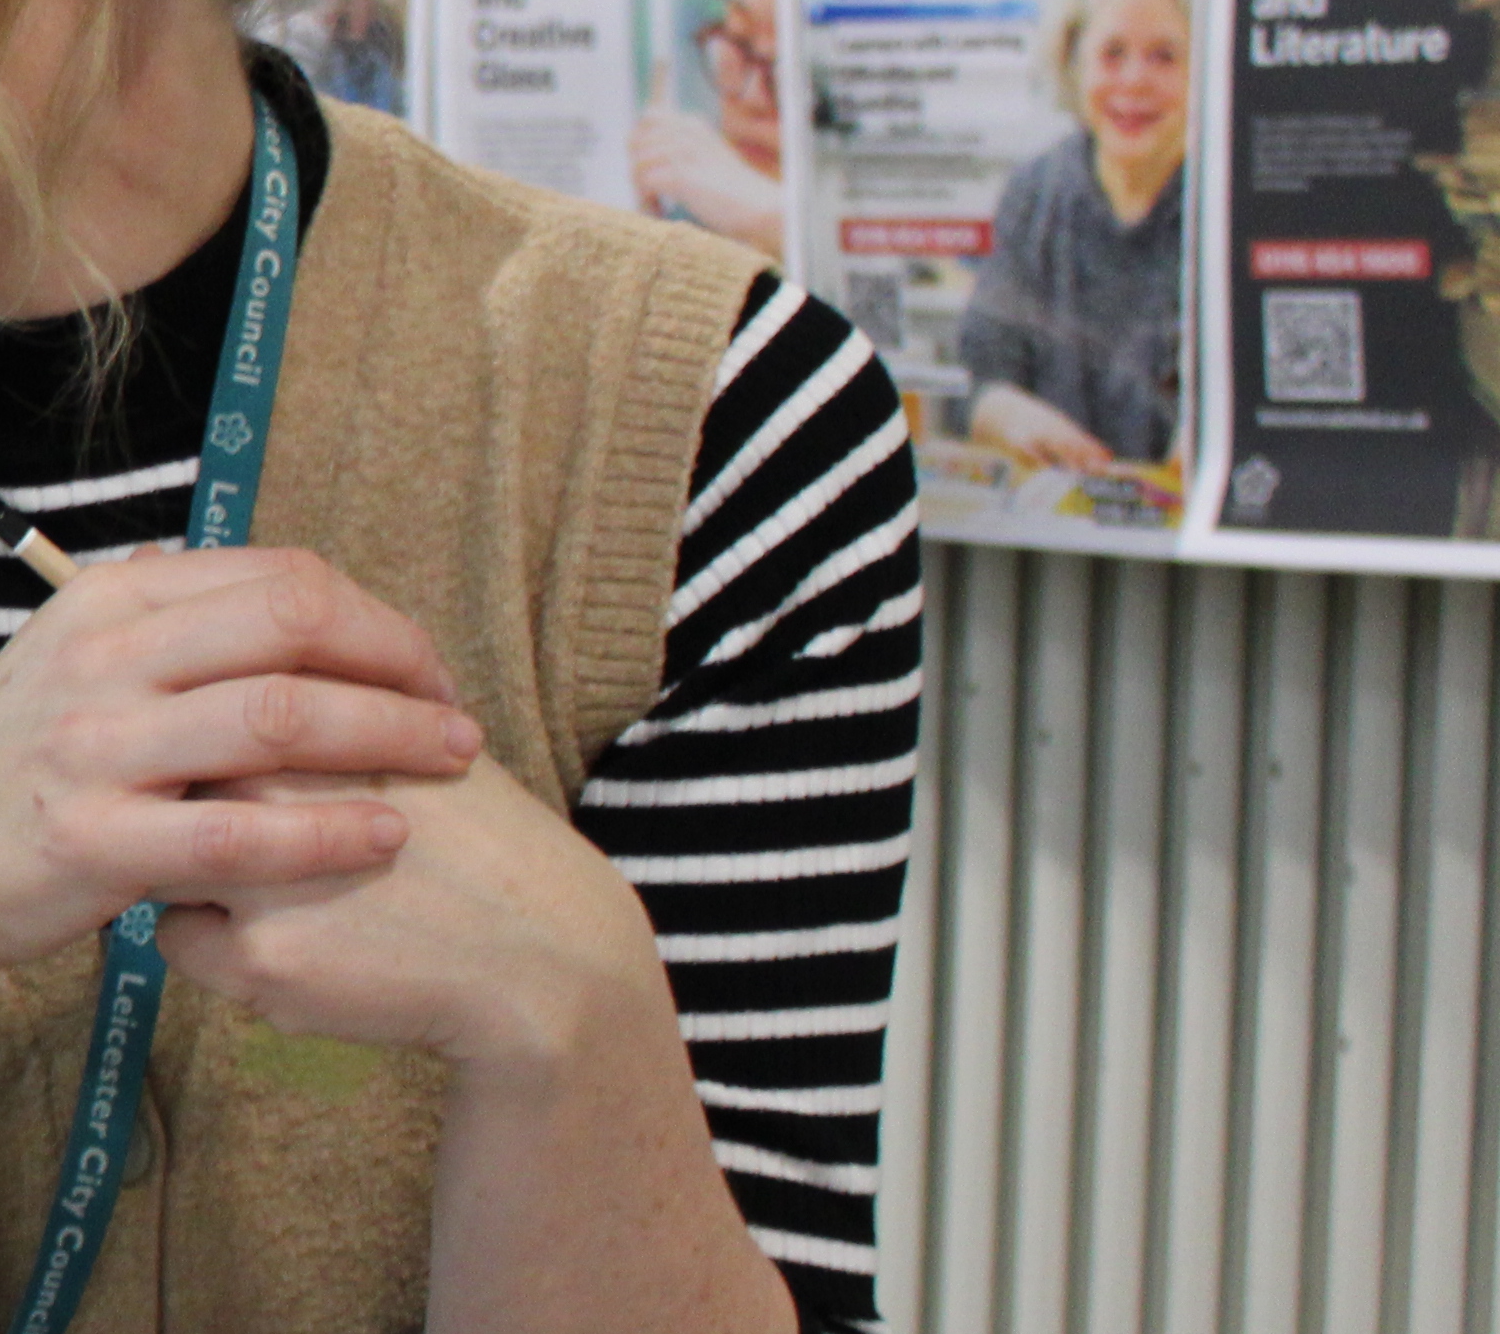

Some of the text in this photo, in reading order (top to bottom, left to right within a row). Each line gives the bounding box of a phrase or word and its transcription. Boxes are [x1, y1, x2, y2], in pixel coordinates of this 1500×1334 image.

[1249, 21, 1451, 67] Literature
[254, 170, 289, 240] City
[233, 249, 281, 387] Council
[88, 972, 149, 1142] Leicester
[61, 1146, 109, 1219] City
